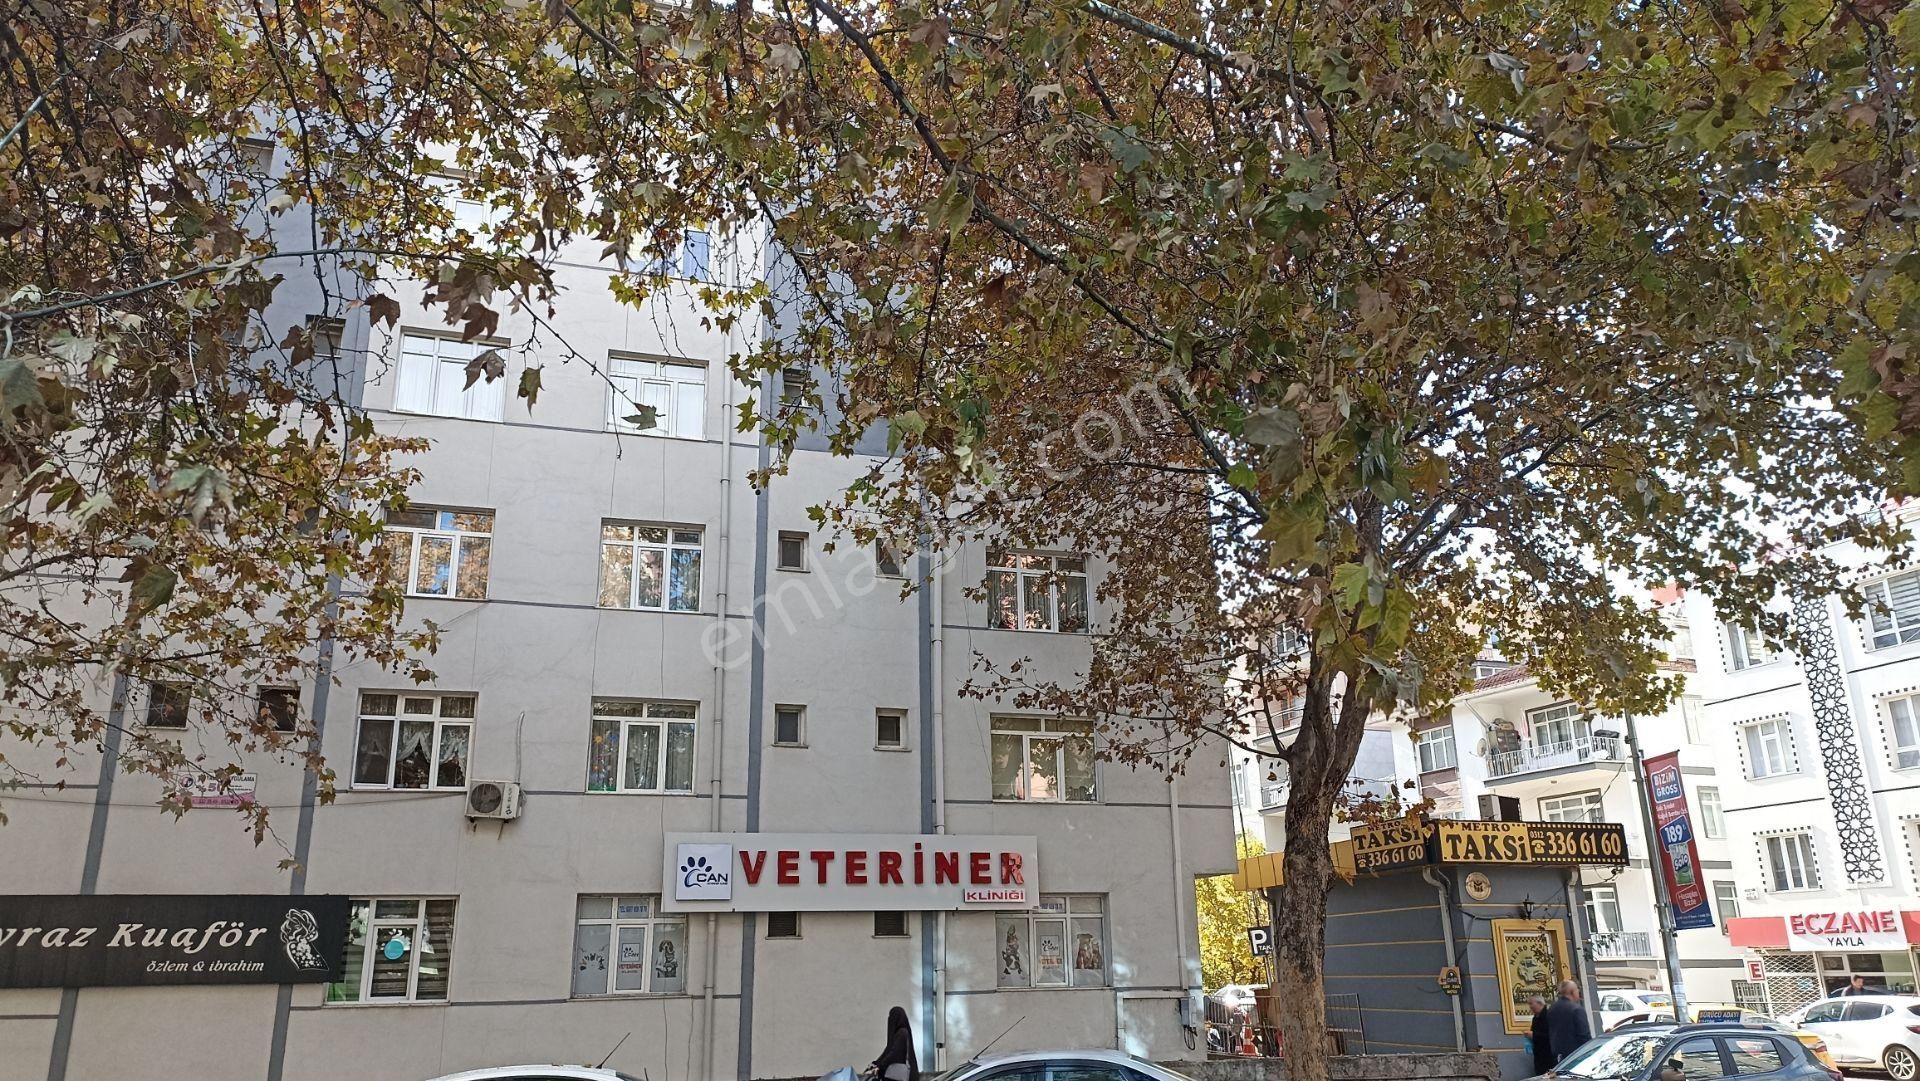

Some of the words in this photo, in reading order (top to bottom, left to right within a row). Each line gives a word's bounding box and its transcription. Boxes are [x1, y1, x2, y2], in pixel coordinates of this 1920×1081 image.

[1656, 784, 1678, 797] GROSS
[1461, 823, 1511, 832] METRO
[1530, 831, 1545, 839] 0312
[1664, 824, 1684, 843] 189
[1546, 832, 1577, 855] 336
[1579, 832, 1598, 856] 61
[1602, 832, 1622, 856] 60
[1368, 850, 1389, 866] 336
[1392, 848, 1405, 863] 61
[1408, 845, 1424, 860] 60
[739, 842, 1025, 885] VETERİNER
[697, 873, 728, 882] CAN
[967, 889, 1024, 901] KLİNİĞİ
[1790, 910, 1898, 935] ECZANE
[106, 920, 267, 954] Kuaför
[1250, 930, 1267, 954] P
[1827, 937, 1865, 947] YAYLA
[147, 960, 188, 972] özlem
[192, 961, 204, 972] &
[208, 960, 264, 972] ibrahim
[1751, 963, 1761, 978] E
